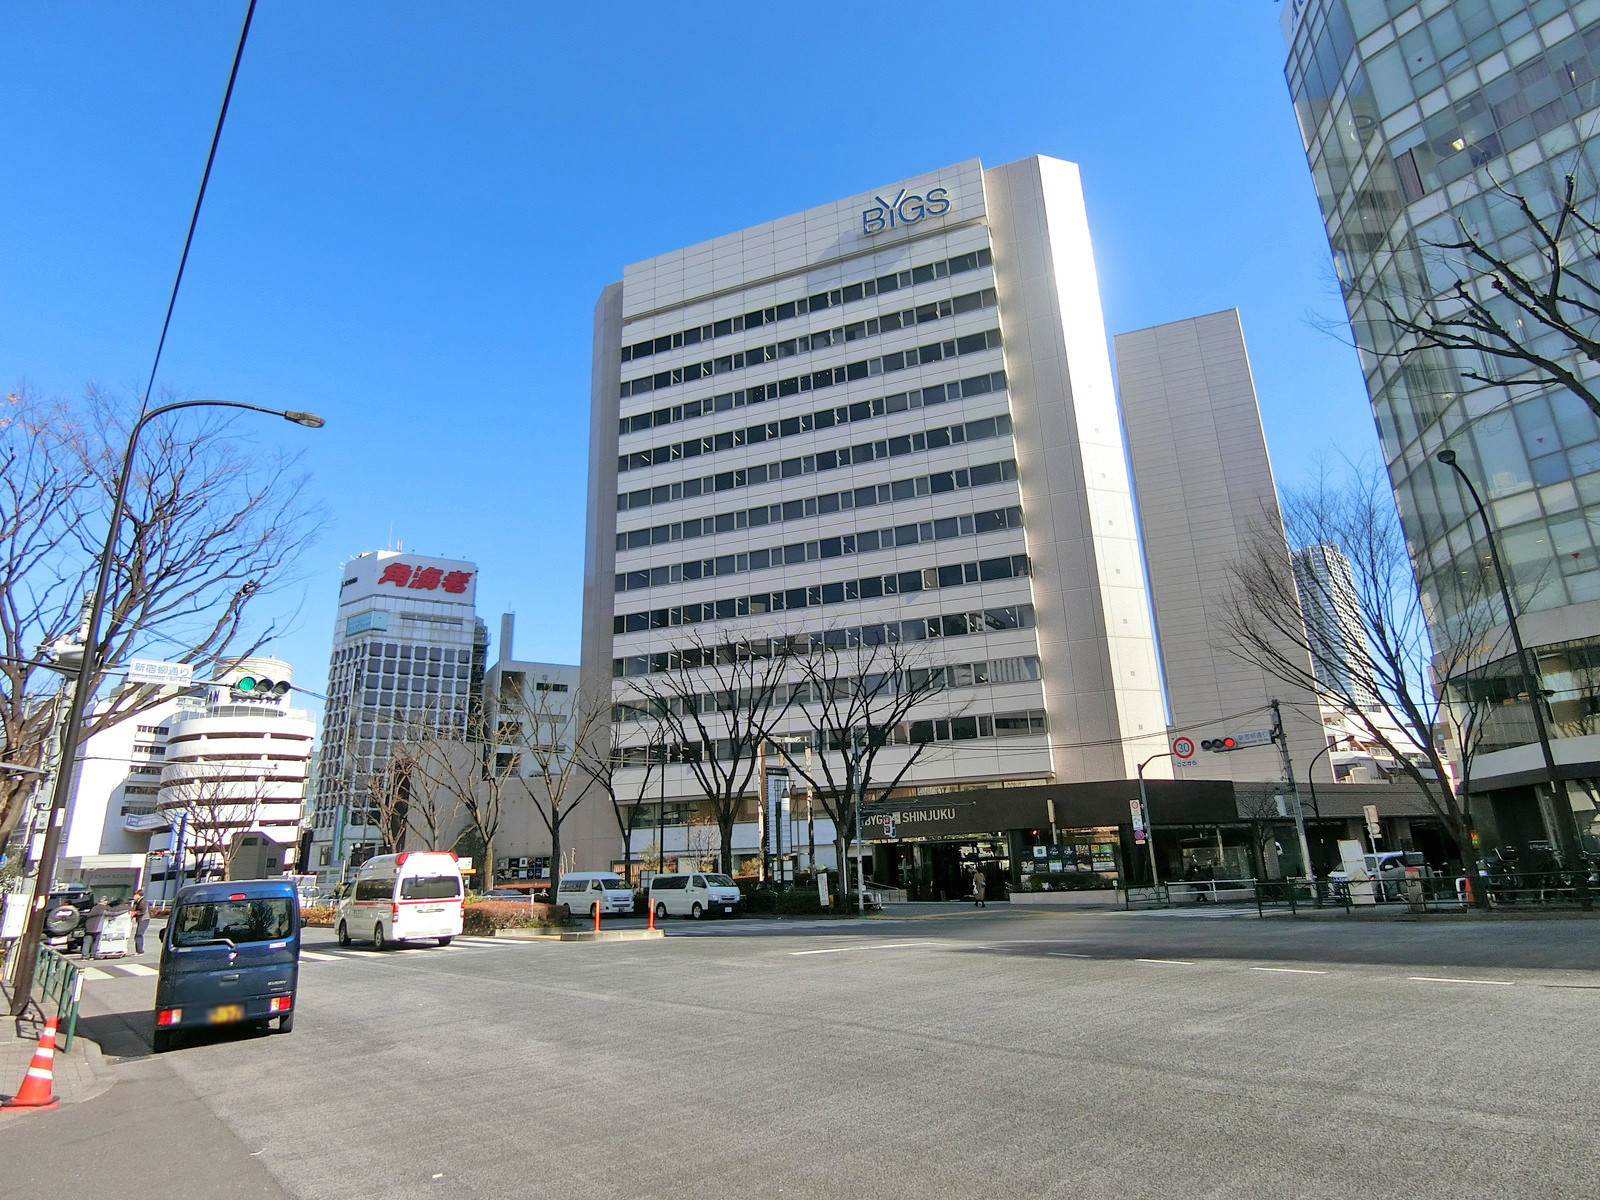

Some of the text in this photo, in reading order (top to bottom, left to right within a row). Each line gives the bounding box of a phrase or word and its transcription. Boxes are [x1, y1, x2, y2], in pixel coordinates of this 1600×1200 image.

[862, 187, 952, 236] BYGS
[378, 562, 473, 594] 角海老
[1177, 742, 1190, 753] 30
[1177, 760, 1197, 768] ここから
[902, 808, 956, 823] SHINJUKU
